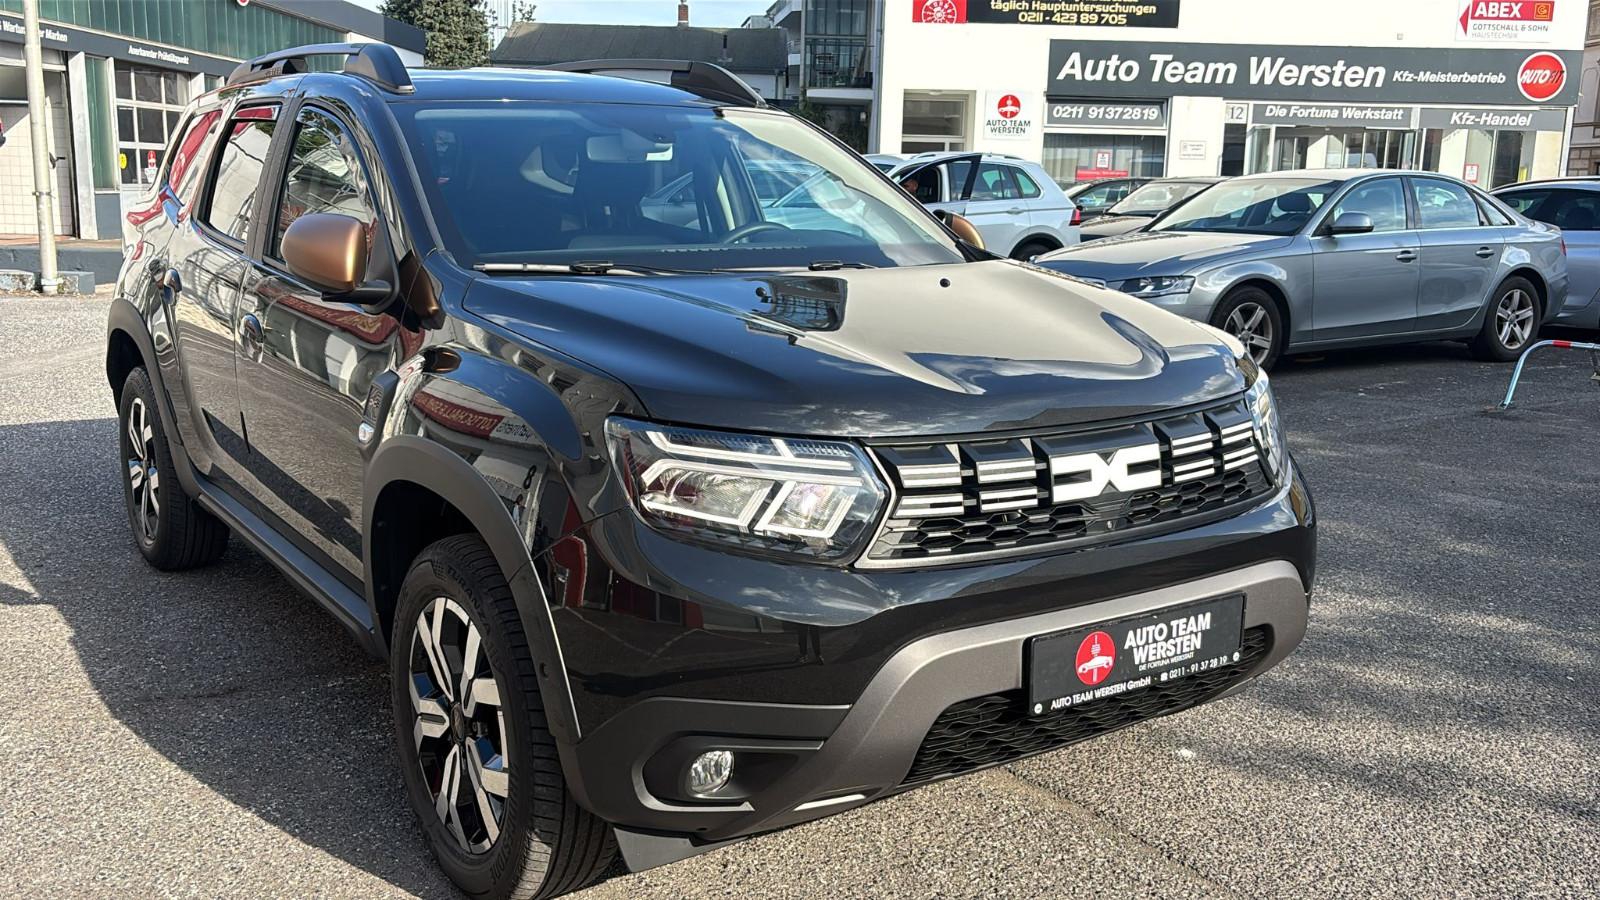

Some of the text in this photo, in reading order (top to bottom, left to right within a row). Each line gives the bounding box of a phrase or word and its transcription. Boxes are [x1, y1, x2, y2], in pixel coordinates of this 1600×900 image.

[990, 0, 1156, 14] täglich Hauptuntersuchungen
[1474, 2, 1523, 18] ABEX
[1018, 12, 1043, 23] 0211
[1052, 12, 1077, 24] 423
[1080, 13, 1098, 24] 89
[1100, 14, 1127, 25] 705
[1056, 52, 1506, 88] Auto Team Wersten Kfz-Meisterbetrieb
[1053, 105, 1159, 120] 0211 91372819
[1228, 106, 1244, 120] 12
[1265, 105, 1404, 120] Die Fortuna Werkstatt
[1450, 111, 1532, 126] Kfz-Handel
[986, 119, 1008, 127] AUTO
[990, 126, 1026, 134] WERSTEN
[1124, 612, 1212, 649] AUTO TEAM
[1132, 632, 1202, 665] WERSTEN
[1051, 697, 1071, 710] AUTO
[1073, 691, 1094, 705] TEAM
[1094, 682, 1127, 698] WERSTEN
[1127, 676, 1151, 690] GmbH
[1169, 666, 1185, 679] 0211
[1190, 662, 1198, 674] 91
[1200, 660, 1209, 671] 37
[1210, 658, 1218, 669] 28
[1219, 655, 1228, 666] 19
